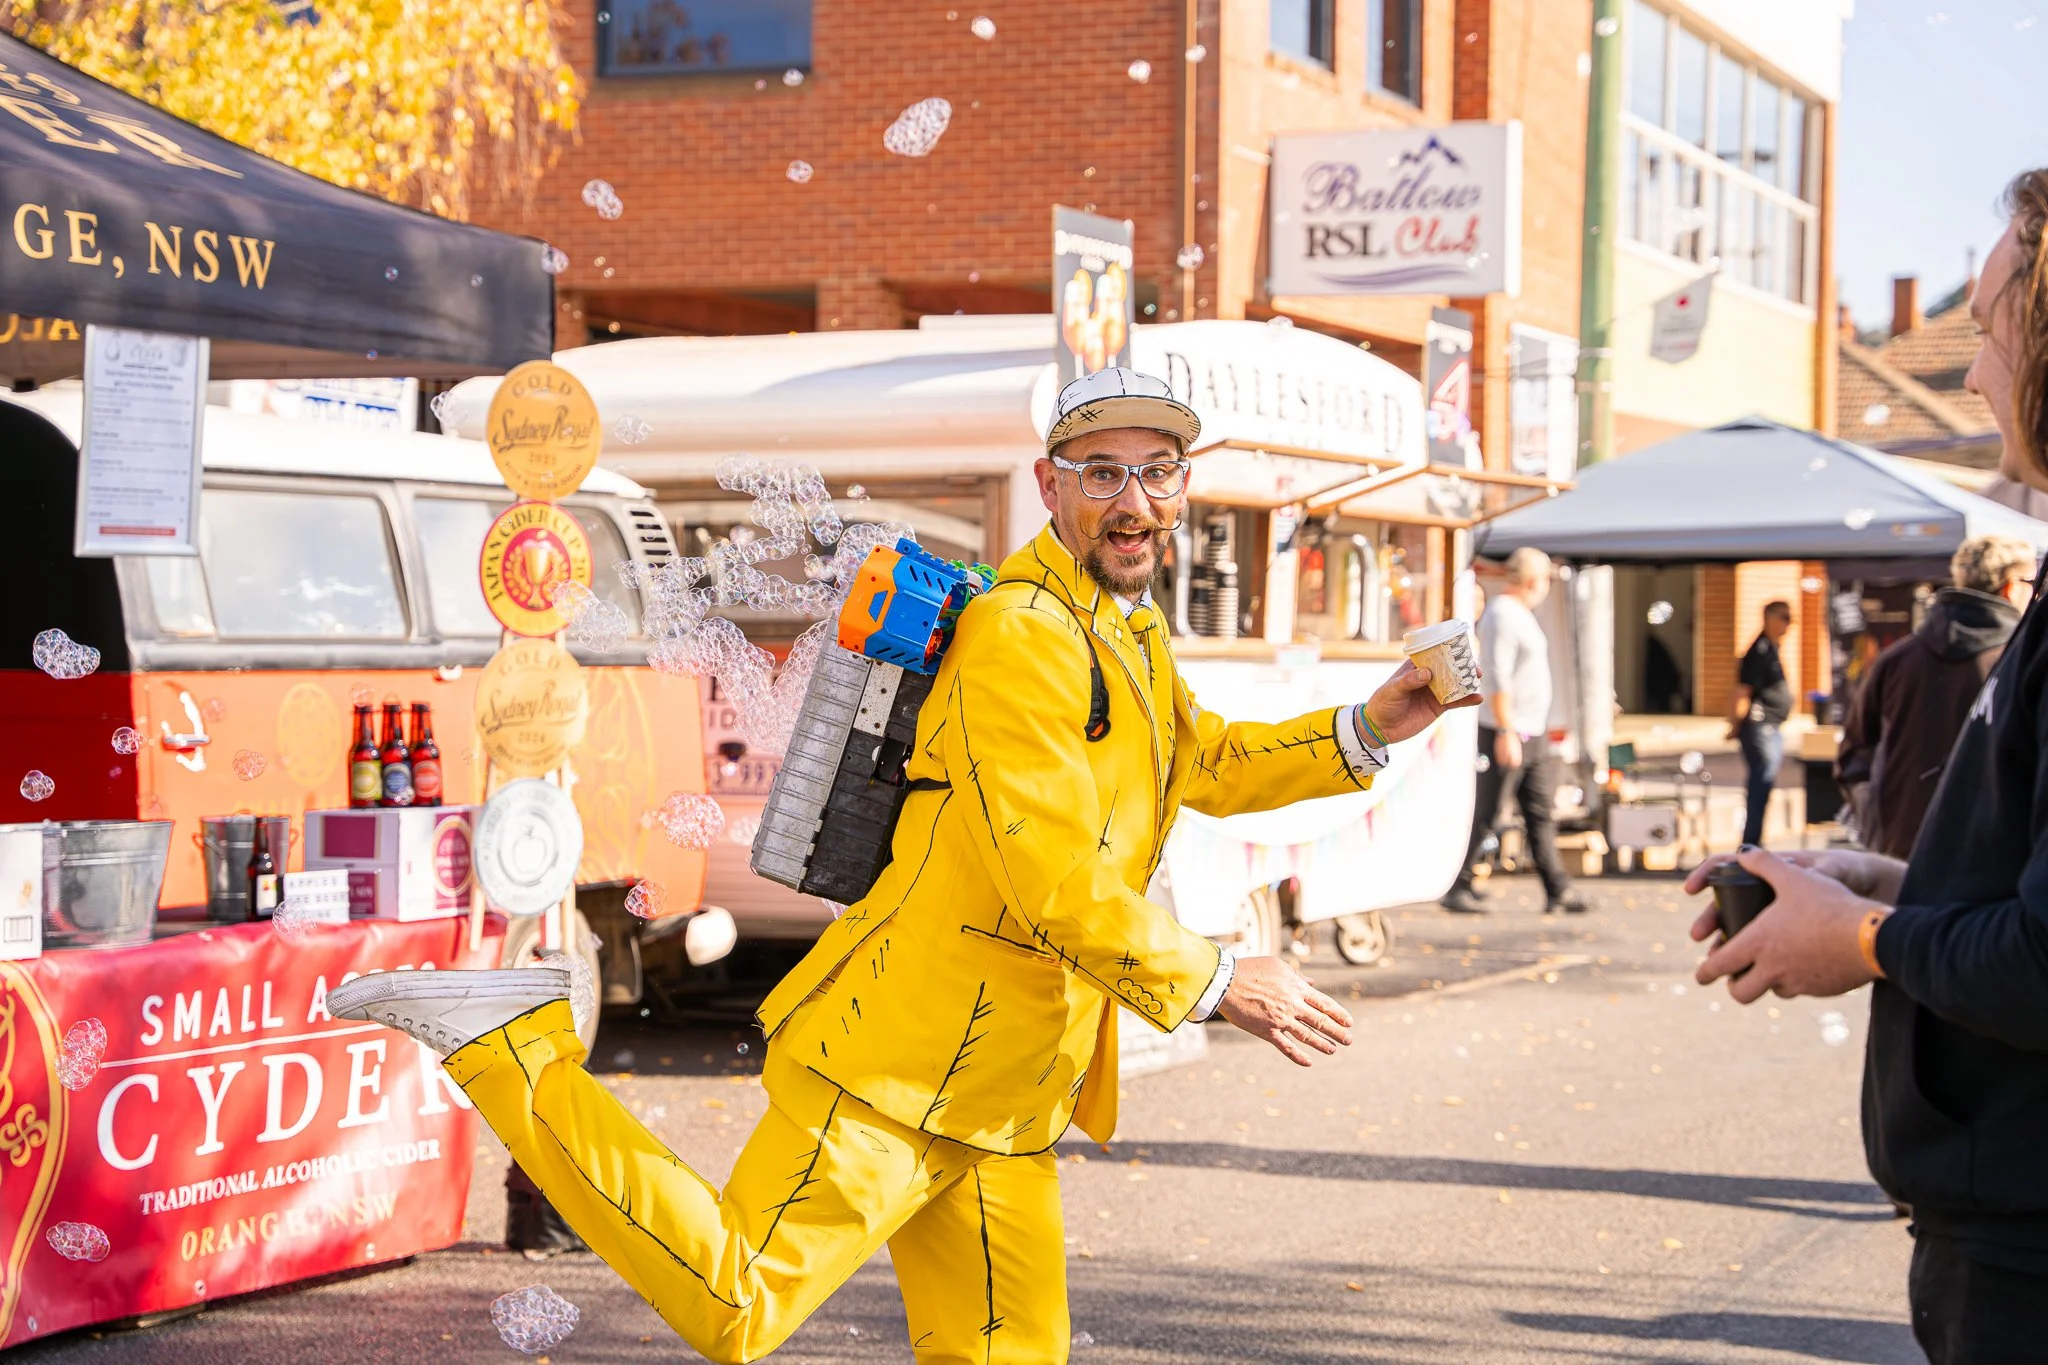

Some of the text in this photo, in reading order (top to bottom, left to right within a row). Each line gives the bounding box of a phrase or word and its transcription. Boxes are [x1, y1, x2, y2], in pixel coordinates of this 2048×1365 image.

[1301, 160, 1483, 214] Batlow
[13, 202, 276, 290] GE, NSW
[1304, 214, 1481, 260] RSL Club
[512, 374, 572, 399] GOLD
[1166, 352, 1403, 453] DAYLESFORD
[492, 407, 552, 453] Sydney
[486, 541, 503, 601] JAPAN
[500, 508, 550, 538] CIDER
[499, 649, 561, 677] GOLD
[481, 689, 537, 735] Sydney
[140, 979, 284, 1047] SMALL
[139, 1137, 442, 1215] TRADITIONAL ALCOHOLIC CIDER
[330, 1191, 399, 1230] NSW
